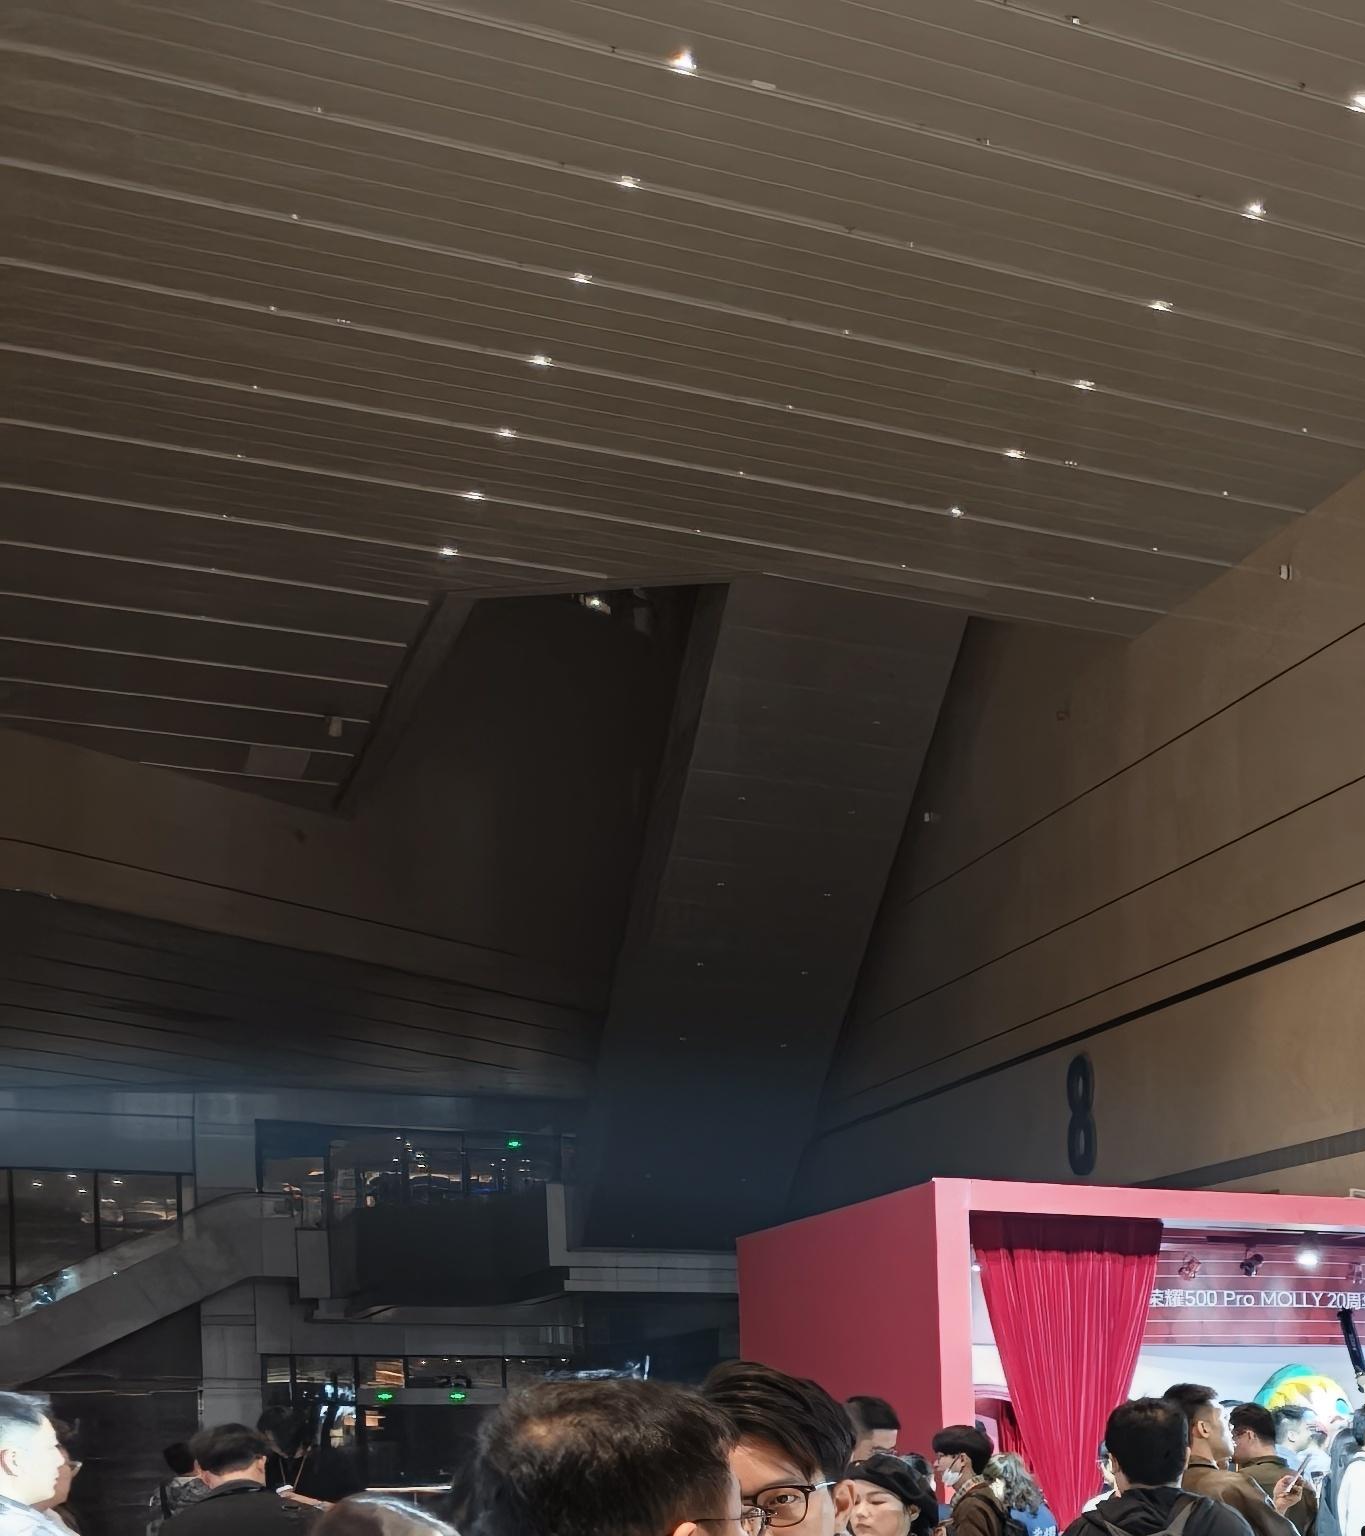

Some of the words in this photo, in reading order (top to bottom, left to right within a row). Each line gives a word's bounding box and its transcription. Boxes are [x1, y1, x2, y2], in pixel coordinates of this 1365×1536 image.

[1066, 1055, 1097, 1176] 8
[1223, 1291, 1255, 1307] Pro
[1260, 1290, 1325, 1308] MOLLY
